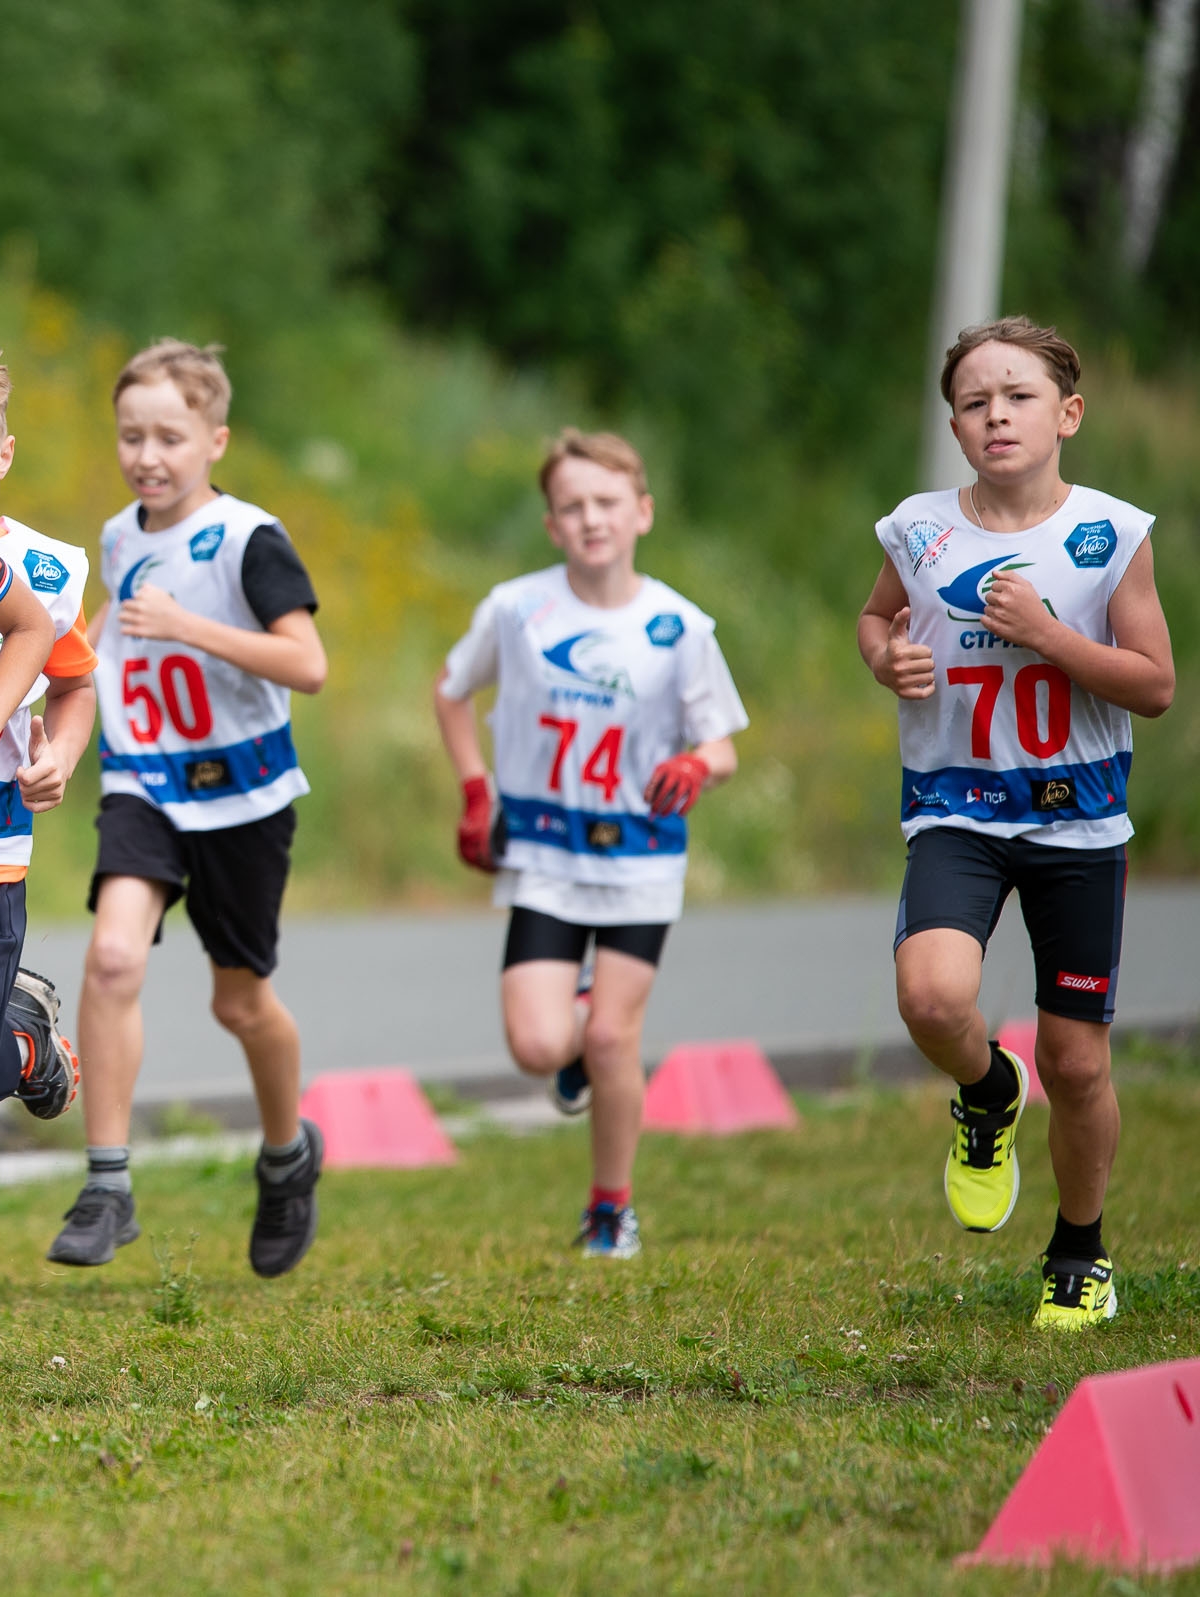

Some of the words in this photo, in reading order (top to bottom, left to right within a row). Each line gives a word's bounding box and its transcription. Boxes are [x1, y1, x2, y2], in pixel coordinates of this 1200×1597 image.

[960, 630, 1024, 650] СТР
[122, 653, 213, 745] 50
[946, 663, 1071, 760] 70
[538, 712, 626, 803] 74
[983, 791, 1007, 804] ПСБ
[1060, 976, 1100, 990] swix
[1090, 1266, 1108, 1278] FILA
